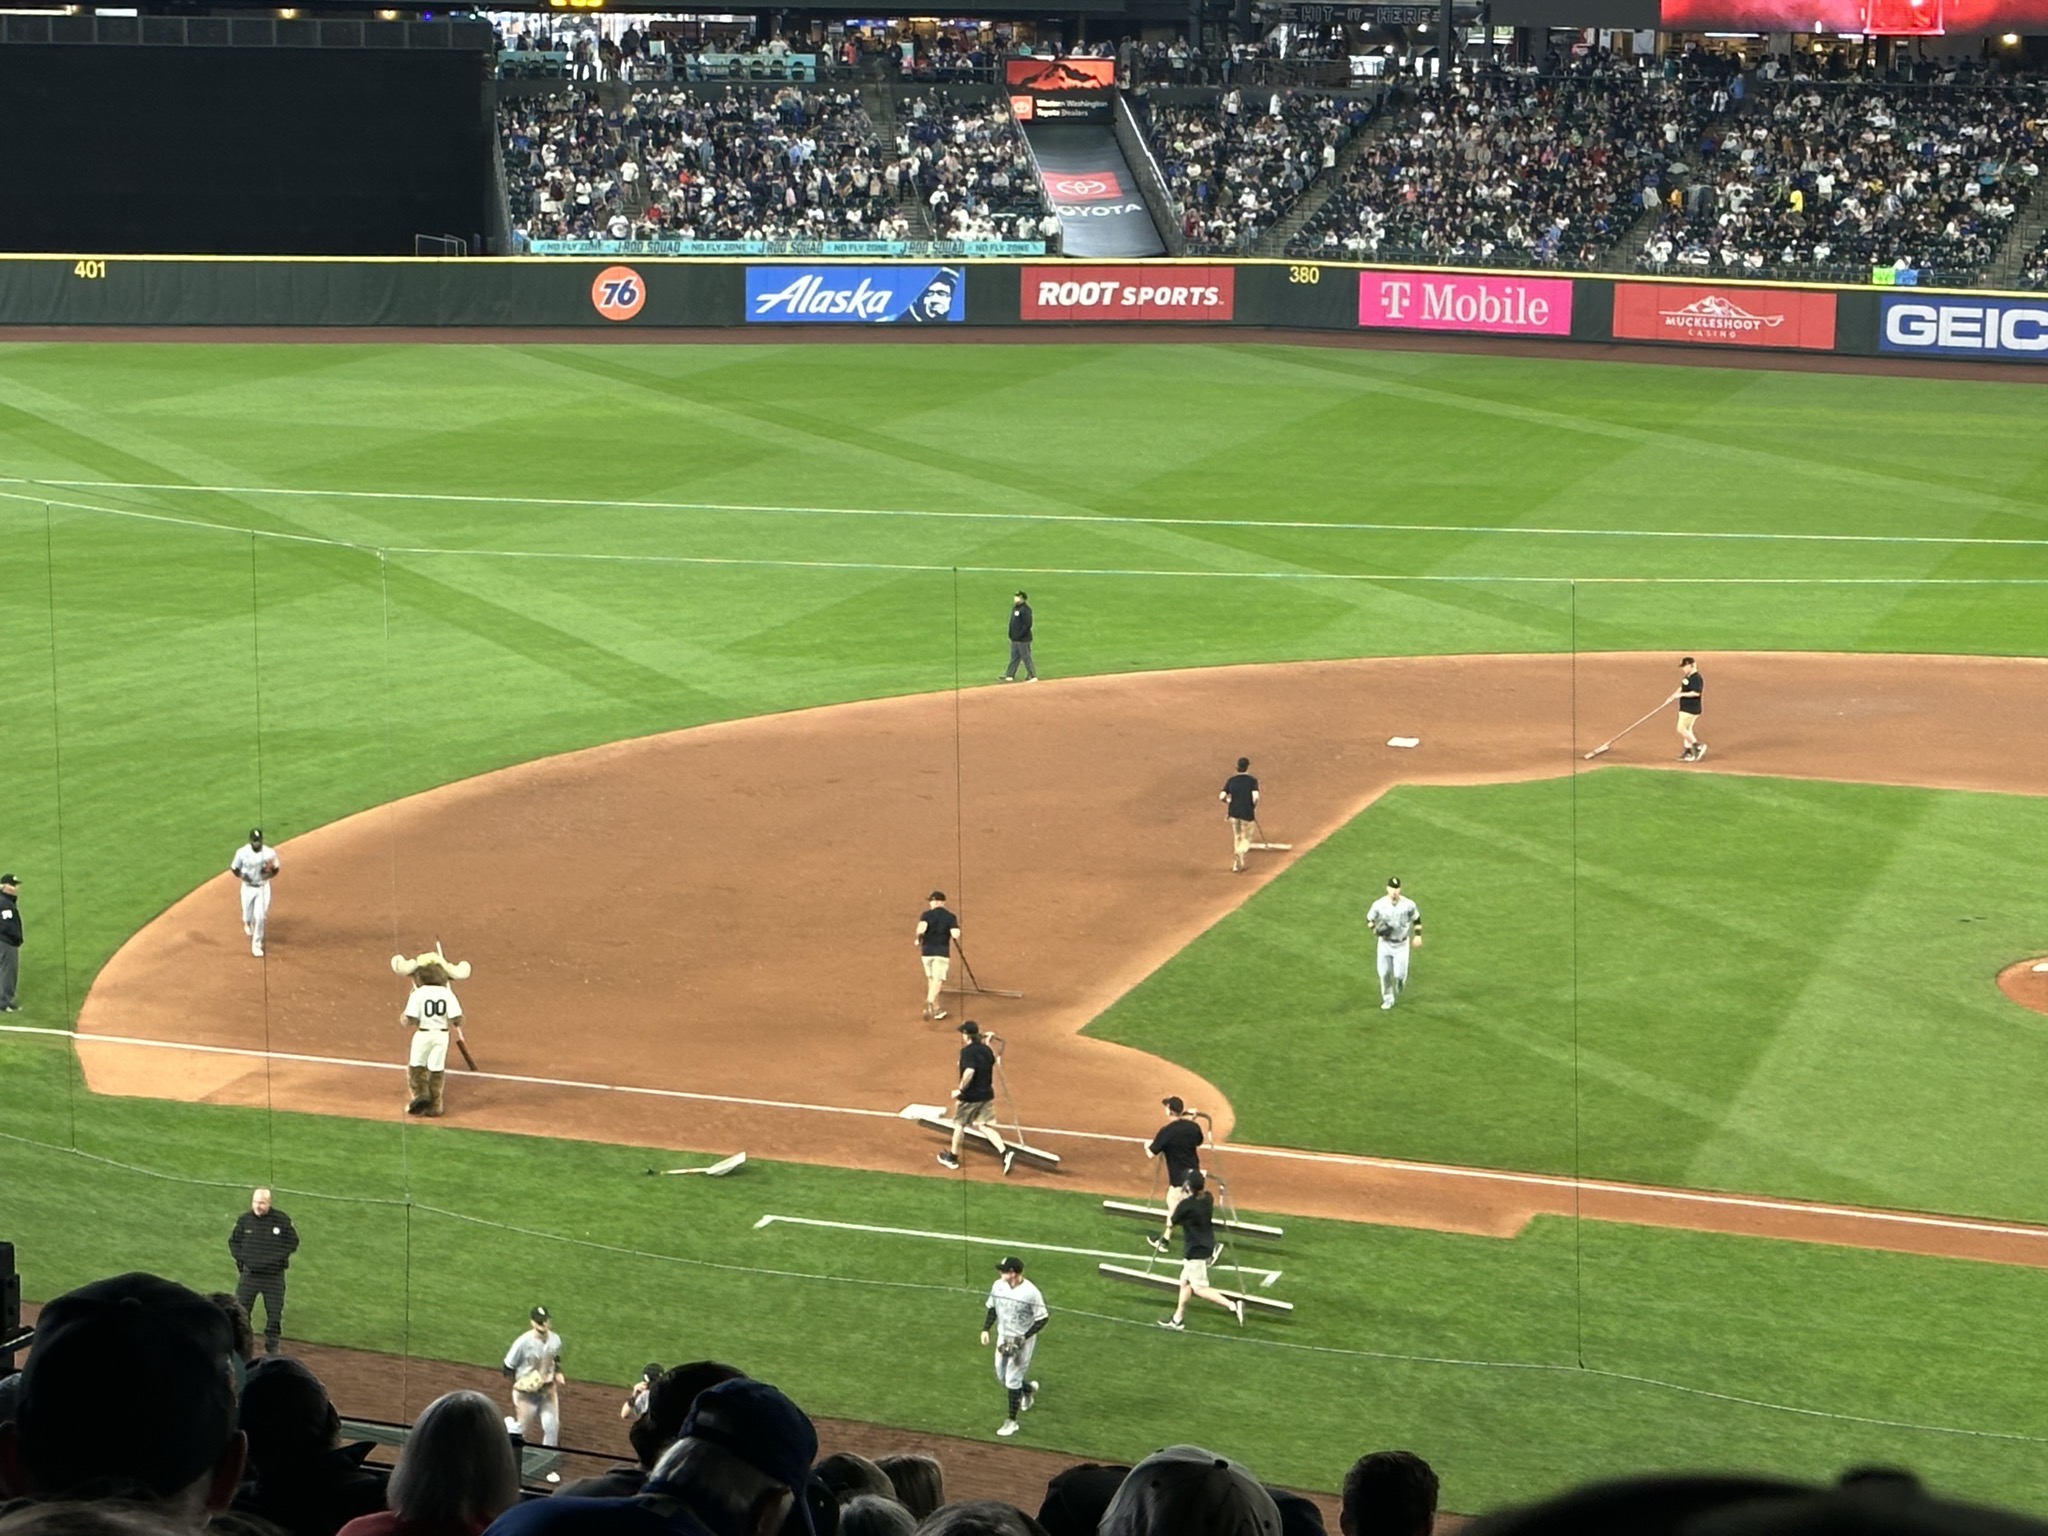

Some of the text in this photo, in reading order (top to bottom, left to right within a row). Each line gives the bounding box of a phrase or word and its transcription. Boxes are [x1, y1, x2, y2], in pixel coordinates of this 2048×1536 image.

[1061, 109, 1088, 117] Dealers
[1066, 99, 1109, 109] Washington
[1052, 203, 1142, 217] OYOTA
[74, 260, 106, 279] 401
[1289, 266, 1320, 284] 380
[599, 276, 639, 308] 76
[756, 274, 893, 319] Alaska
[1038, 281, 1120, 306] ROOT
[1665, 316, 1761, 331] MUCKLESHOOT
[1688, 329, 1737, 340] CASINO
[424, 999, 447, 1018] 00
